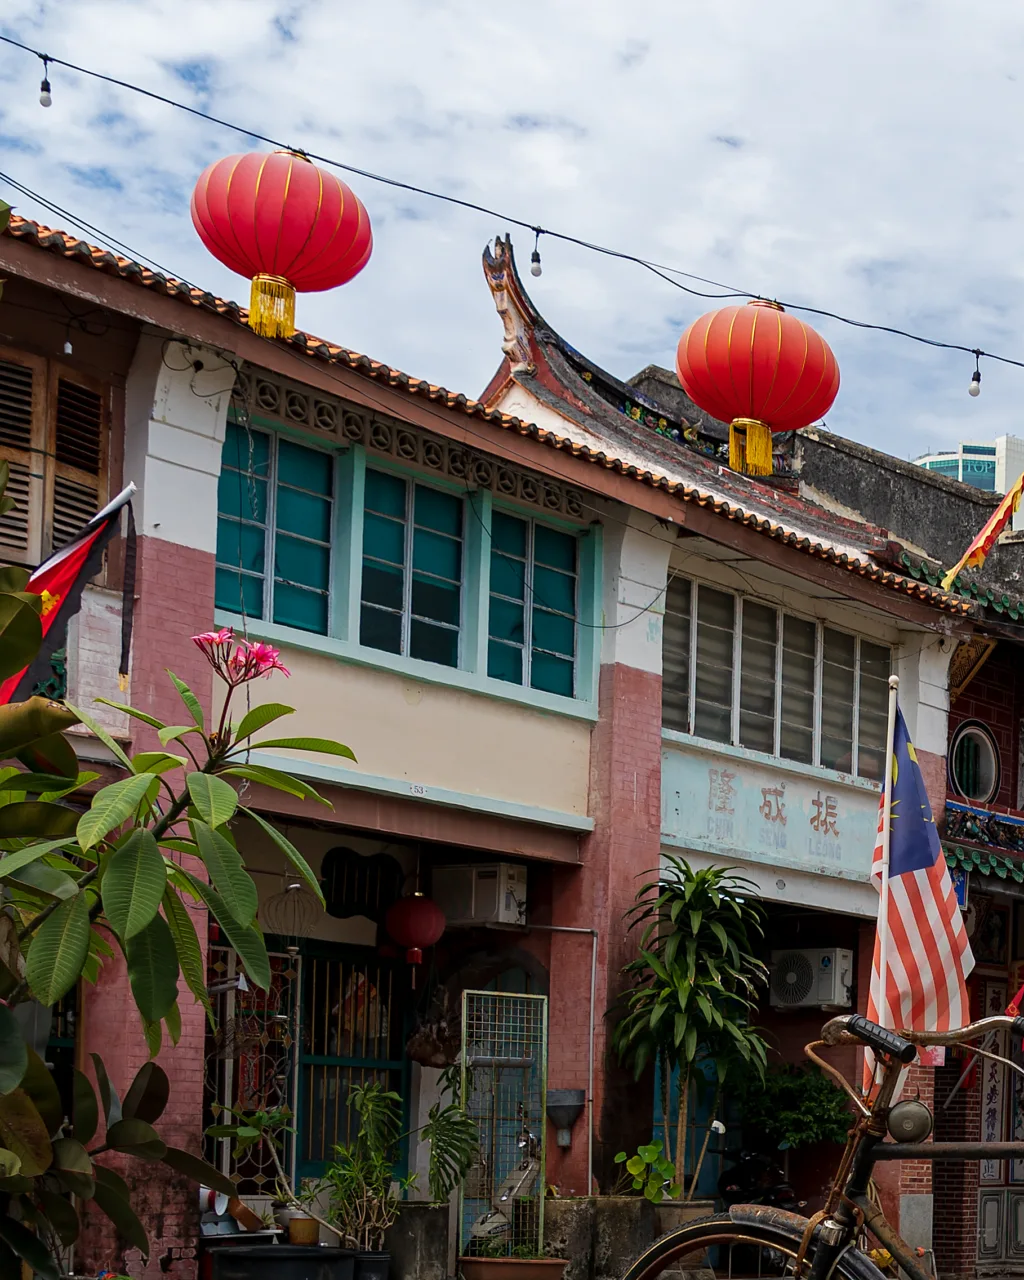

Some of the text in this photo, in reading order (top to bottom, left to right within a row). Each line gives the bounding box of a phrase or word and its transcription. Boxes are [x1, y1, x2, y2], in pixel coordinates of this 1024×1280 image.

[964, 460, 993, 474] TOP
[414, 785, 424, 795] 53
[808, 837, 842, 861] LEONG
